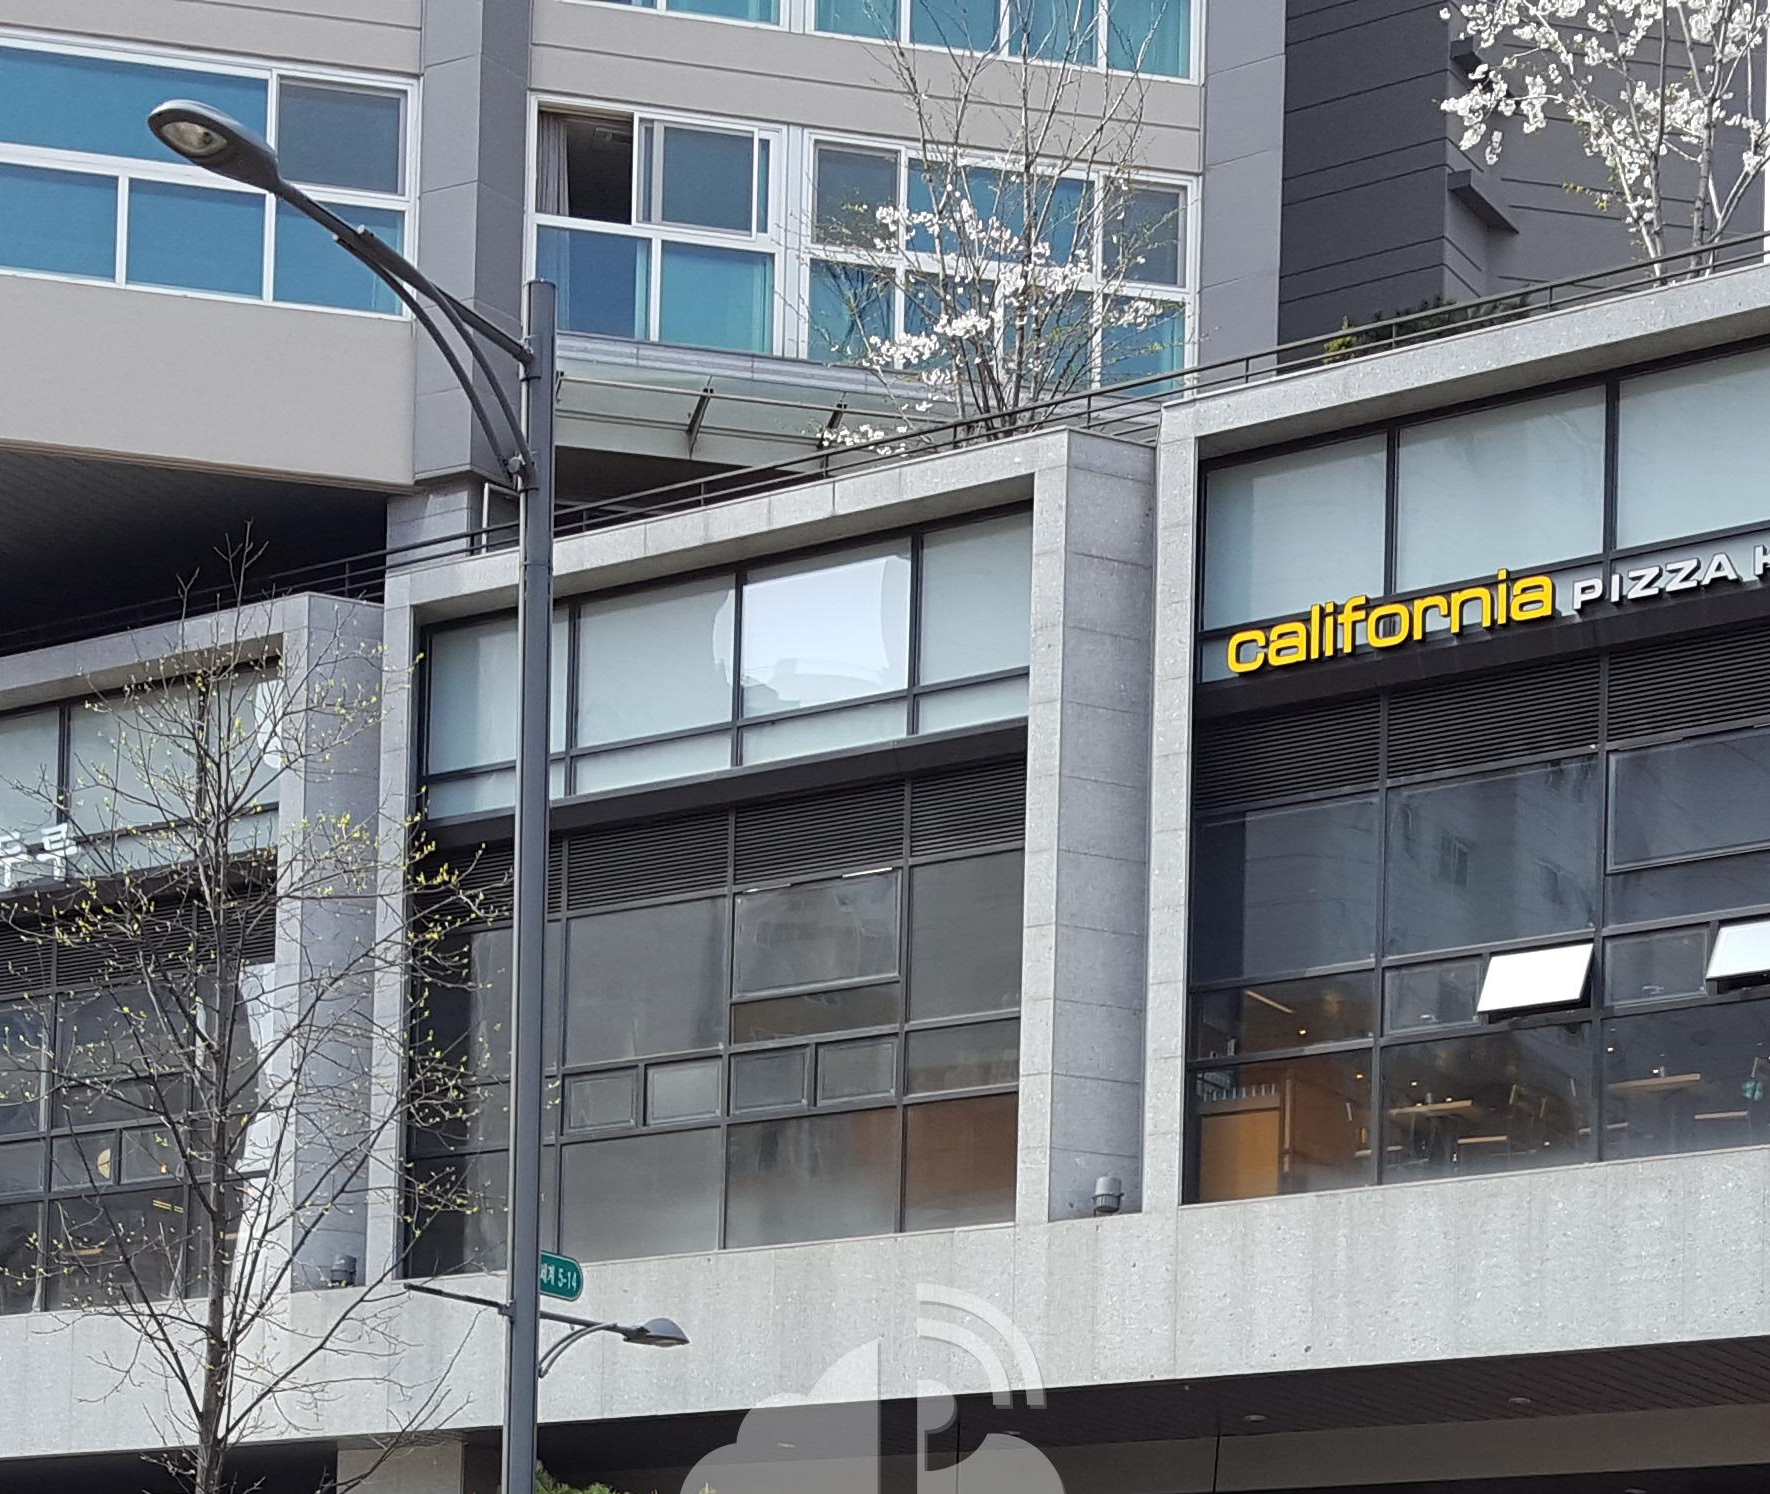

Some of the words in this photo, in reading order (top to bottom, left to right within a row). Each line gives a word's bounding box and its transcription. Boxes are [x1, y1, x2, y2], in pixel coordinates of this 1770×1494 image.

[1227, 568, 1554, 674] california
[1572, 553, 1738, 611] PIZZA
[558, 1268, 577, 1291] 5-14
